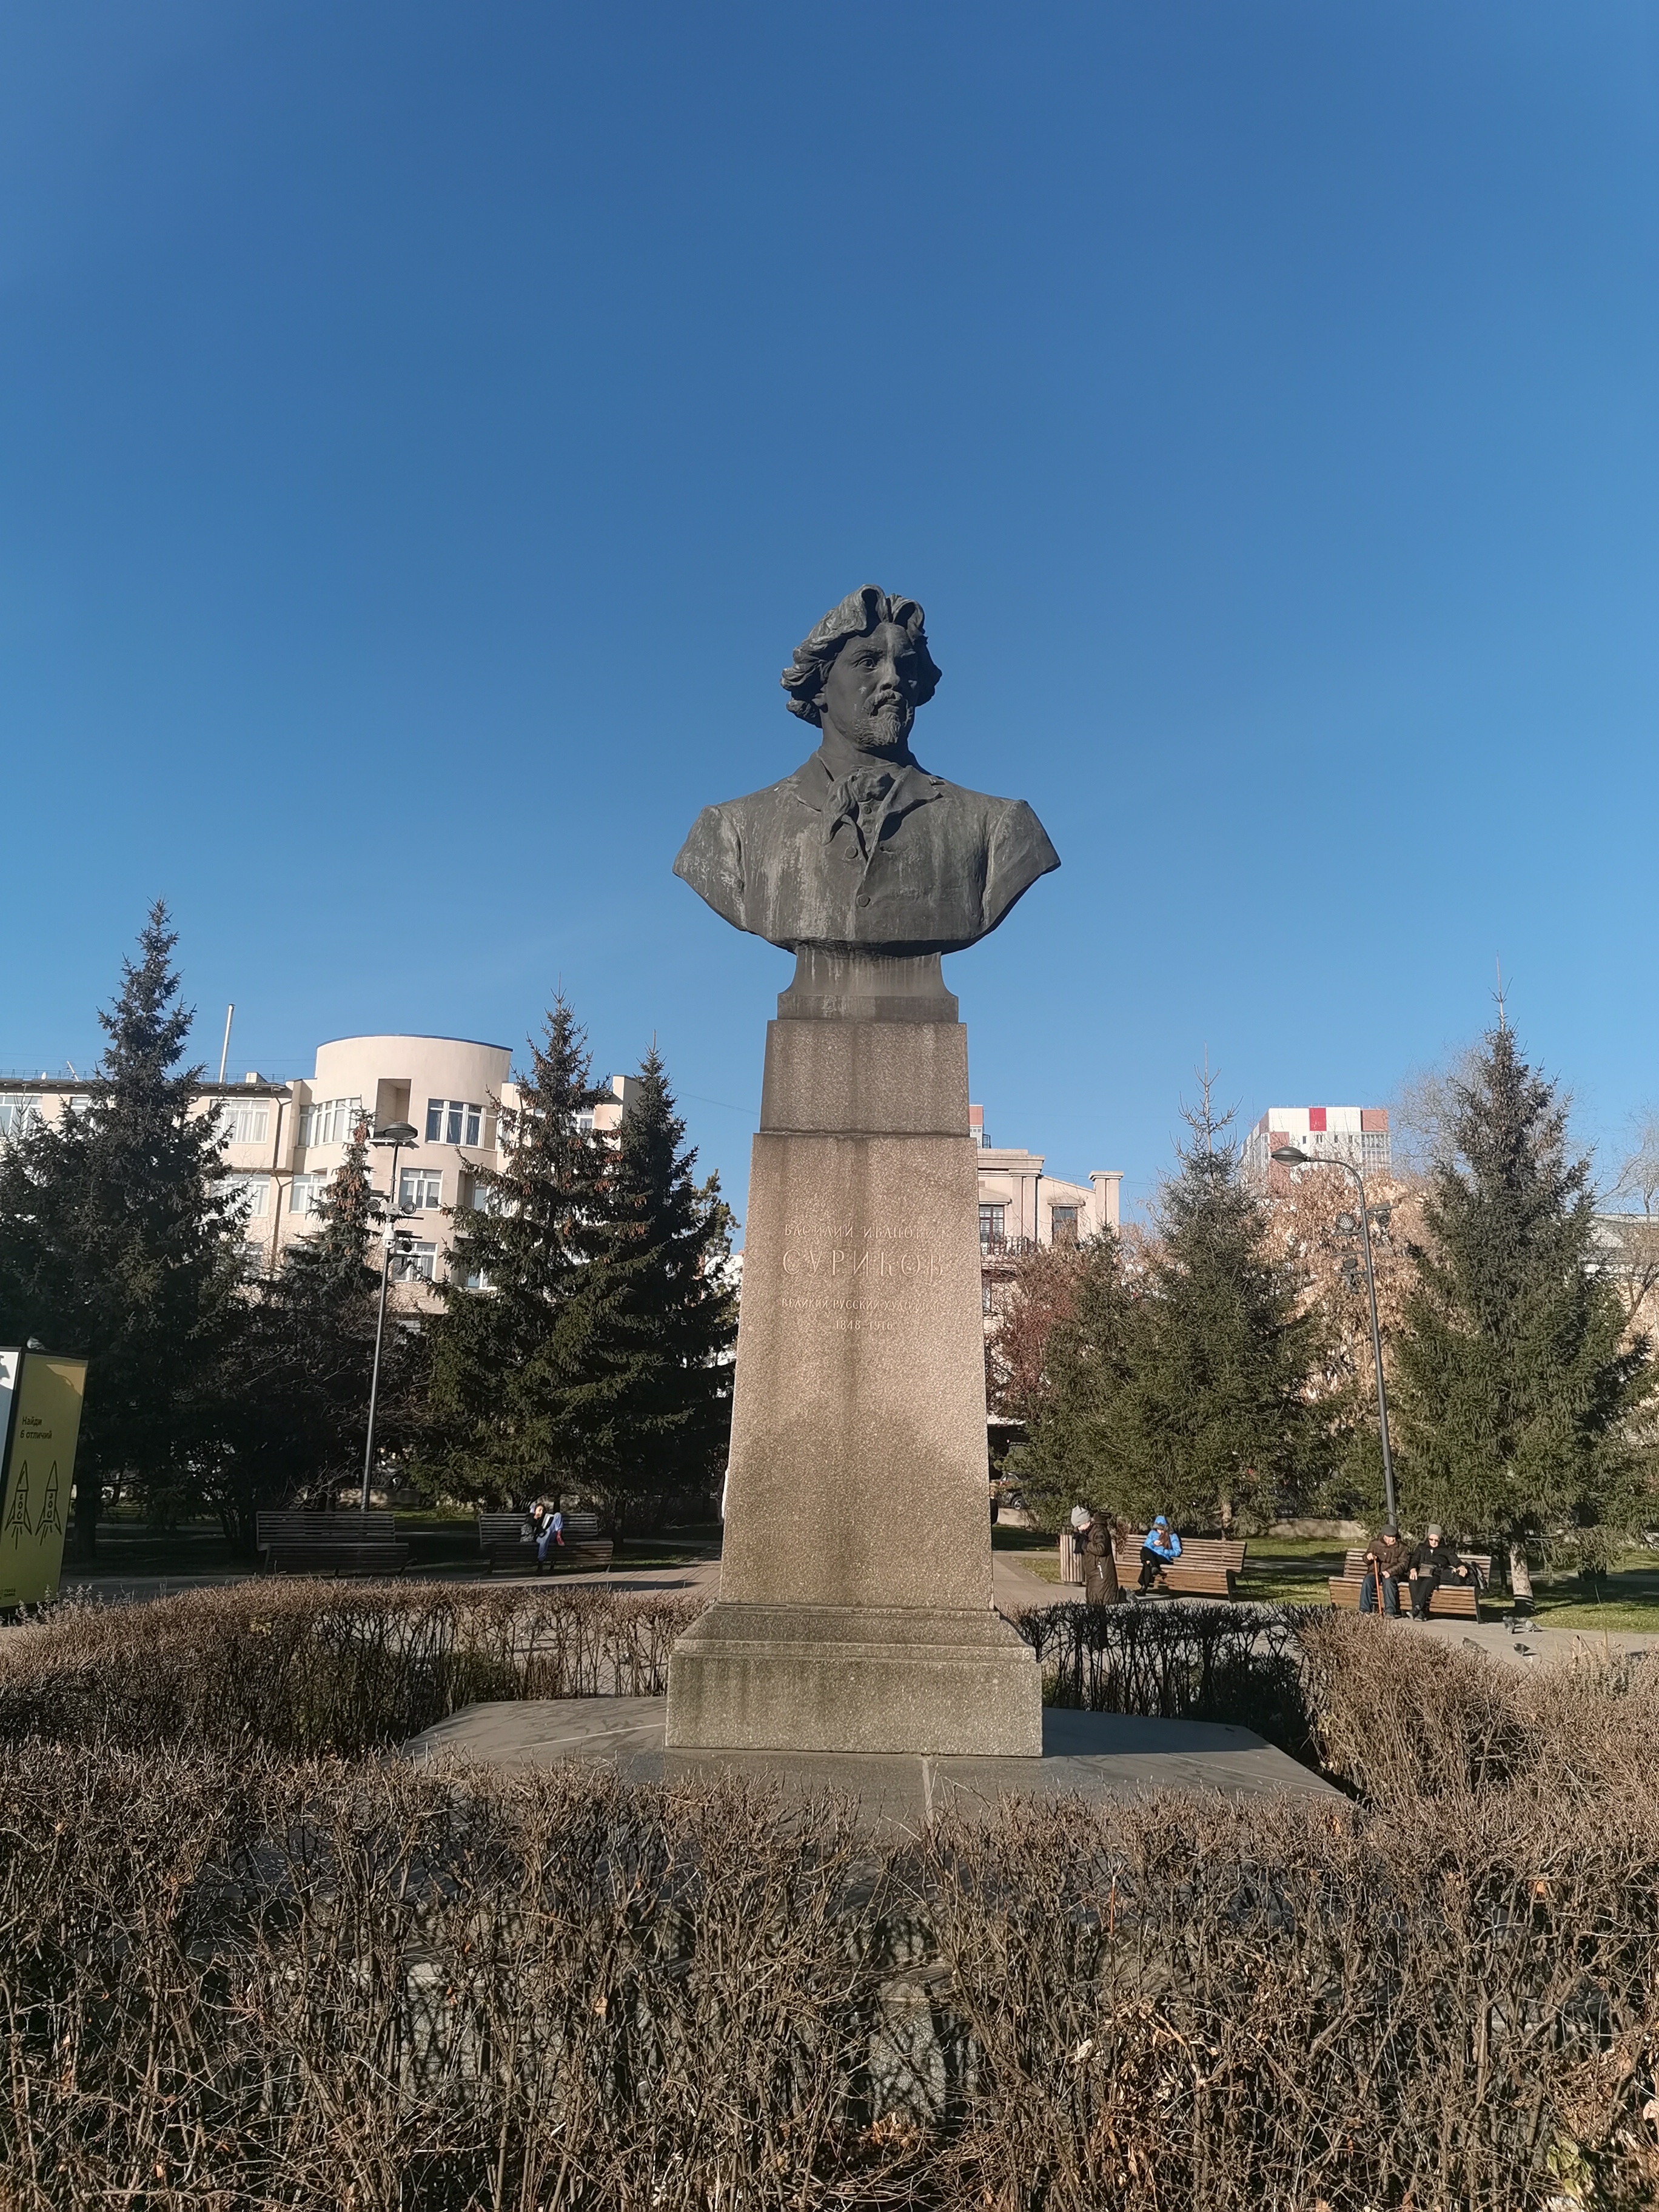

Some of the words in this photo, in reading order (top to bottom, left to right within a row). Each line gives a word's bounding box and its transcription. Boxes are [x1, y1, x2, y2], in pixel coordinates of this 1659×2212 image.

[782, 1248, 943, 1278] СУРИКОВ
[22, 1416, 42, 1427] Найди
[19, 1430, 25, 1439] 6
[25, 1430, 53, 1439] отличий
